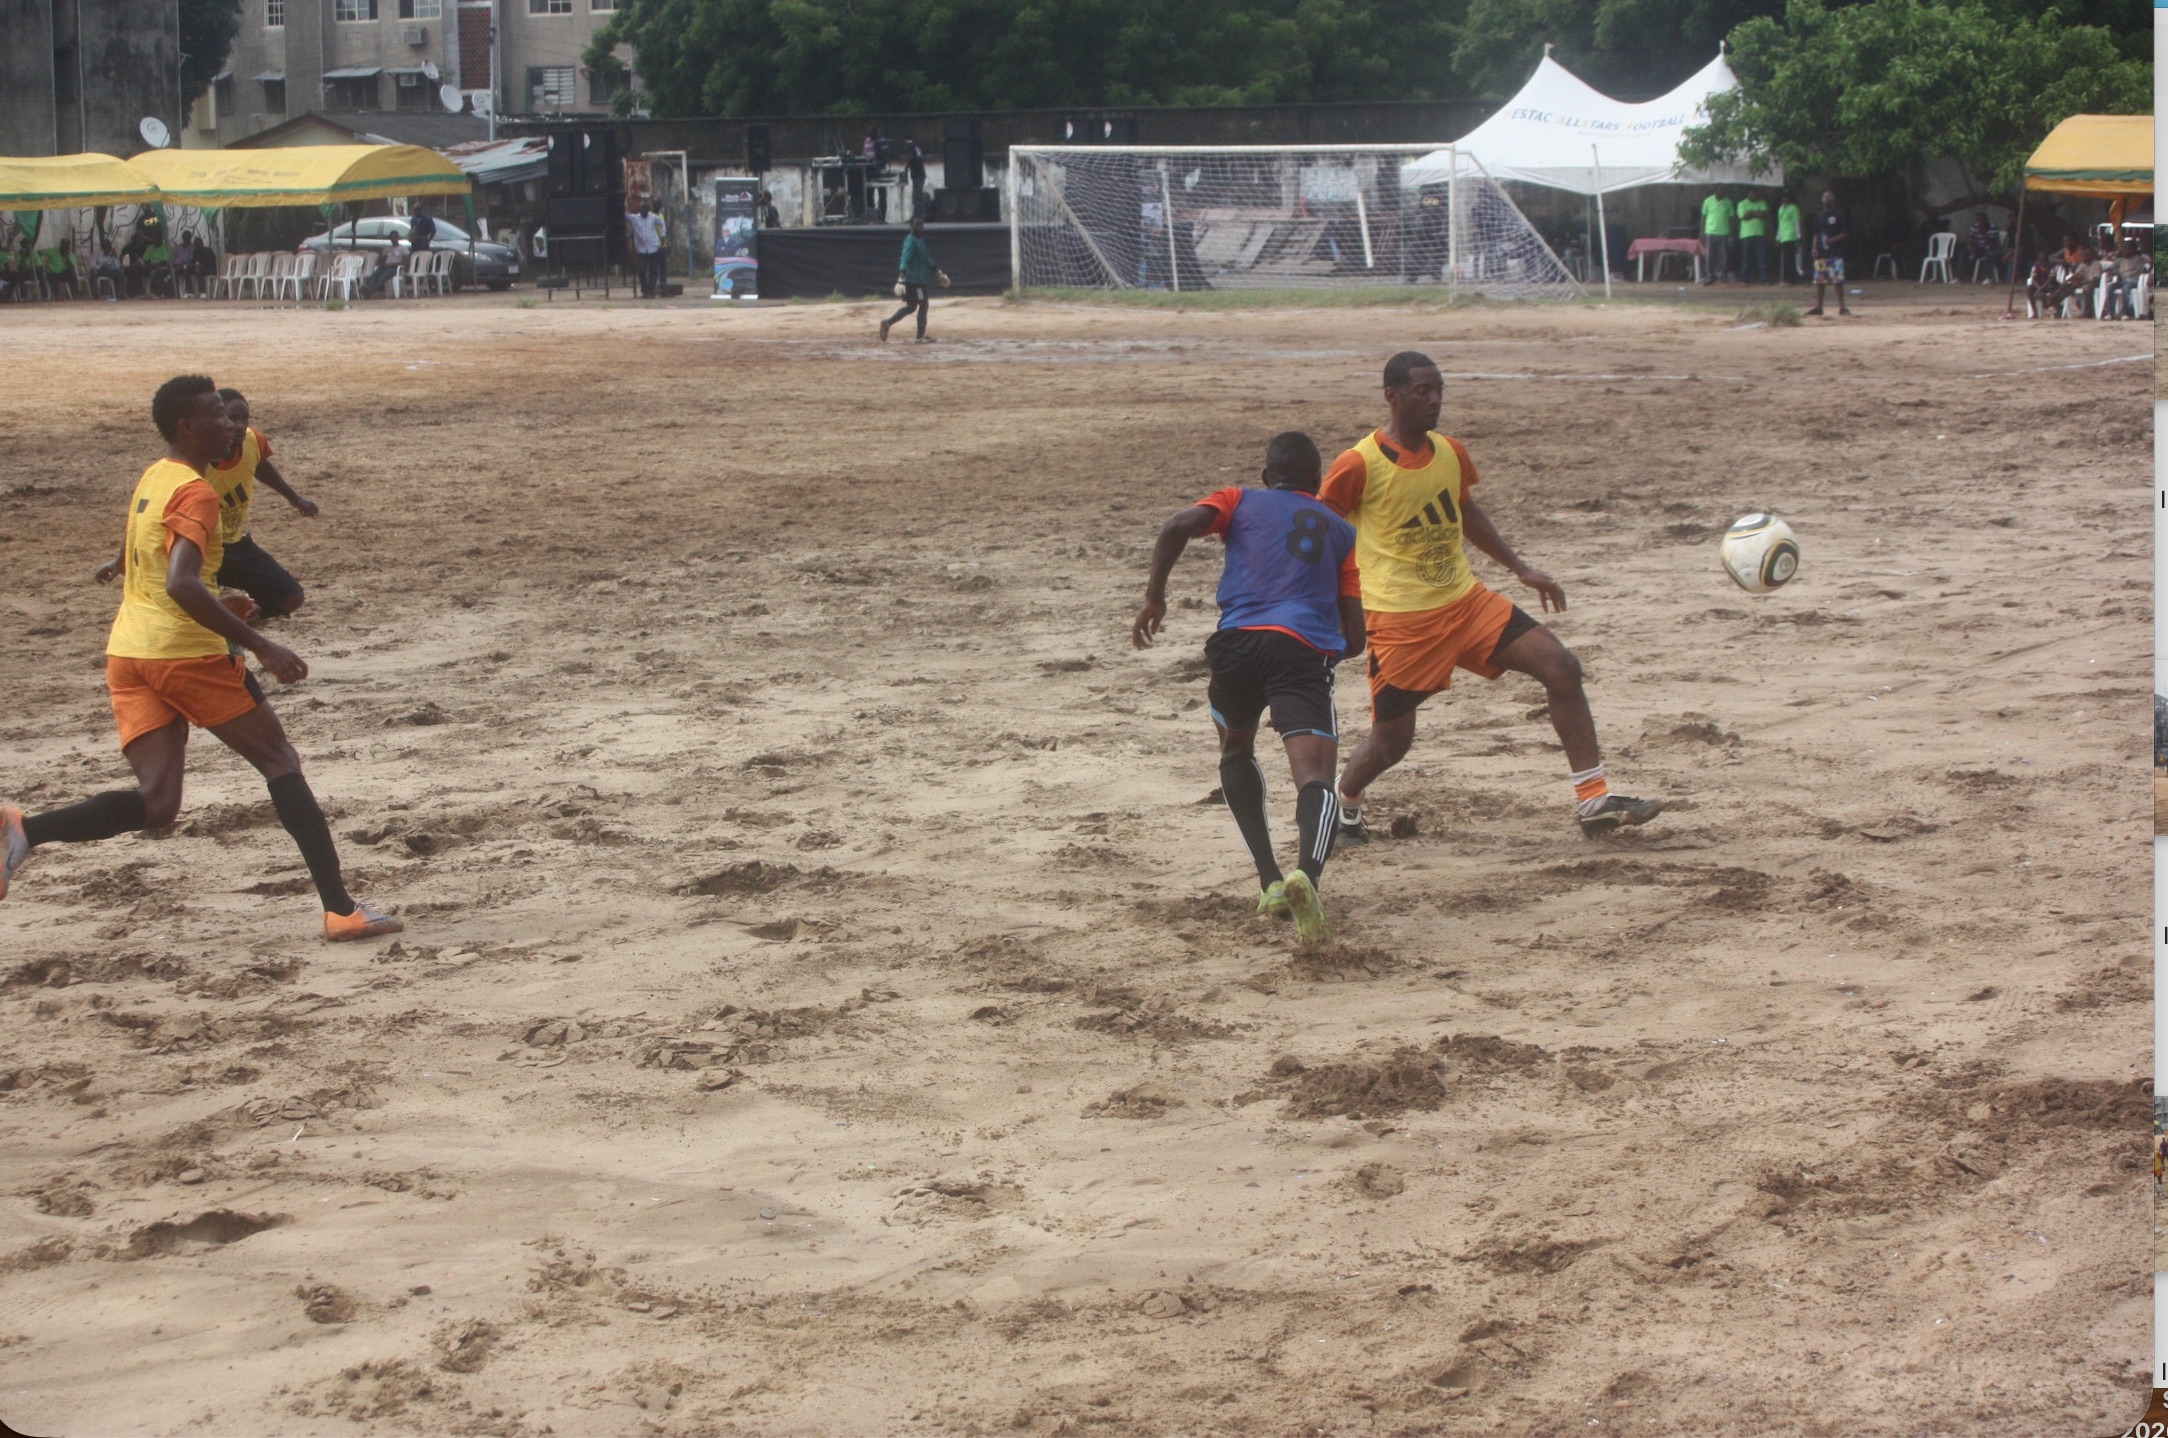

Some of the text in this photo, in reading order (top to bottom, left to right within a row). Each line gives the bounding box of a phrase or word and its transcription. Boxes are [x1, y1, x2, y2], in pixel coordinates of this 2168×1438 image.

[1625, 112, 1685, 131] FOOTBALL
[1286, 508, 1330, 565] 8
[1396, 524, 1460, 546] adidas
